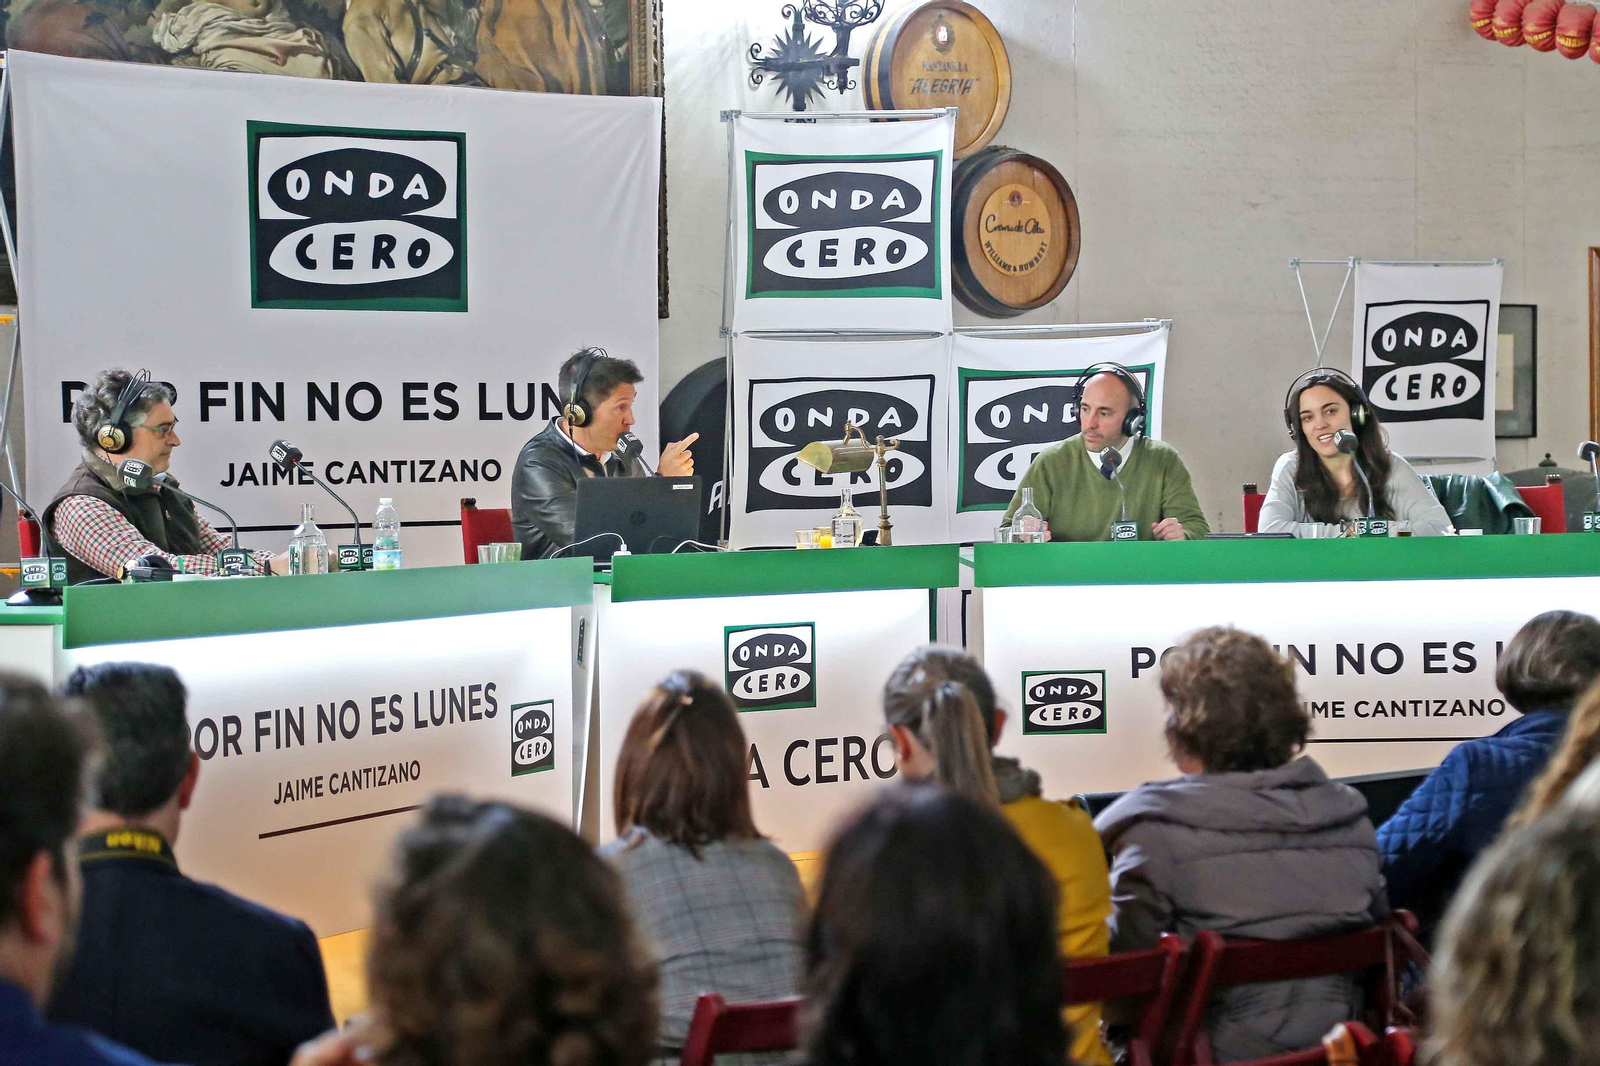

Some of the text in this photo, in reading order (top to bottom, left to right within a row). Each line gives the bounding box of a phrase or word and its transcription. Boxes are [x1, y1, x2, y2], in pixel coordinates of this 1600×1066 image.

[286, 168, 430, 201] ONDA
[778, 188, 906, 215] ONDA
[295, 233, 431, 271] CERO
[786, 237, 907, 268] CERO
[984, 240, 1012, 272] WILLIAMS
[1381, 327, 1468, 352] ONDA
[1385, 373, 1467, 401] CERO
[199, 381, 285, 423] FIN
[307, 381, 383, 422] NO
[402, 381, 460, 421] ES
[478, 382, 564, 421] LUN
[774, 406, 902, 433] ONDA
[220, 458, 502, 487] JAIME CANTIZANO
[739, 642, 800, 662] ONDA
[1335, 642, 1405, 675] NO
[1422, 641, 1478, 674] ES
[743, 672, 801, 694] CERO
[1035, 684, 1092, 698] ONDA
[187, 682, 498, 761] OR FIN NO ES LUNES
[1038, 706, 1092, 721] CERO
[1353, 698, 1507, 718] CANTIZANO
[517, 716, 548, 734] ONDA
[519, 741, 548, 760] CERO
[783, 732, 898, 787] CERO
[273, 760, 422, 805] JAIME CANTIZANO
